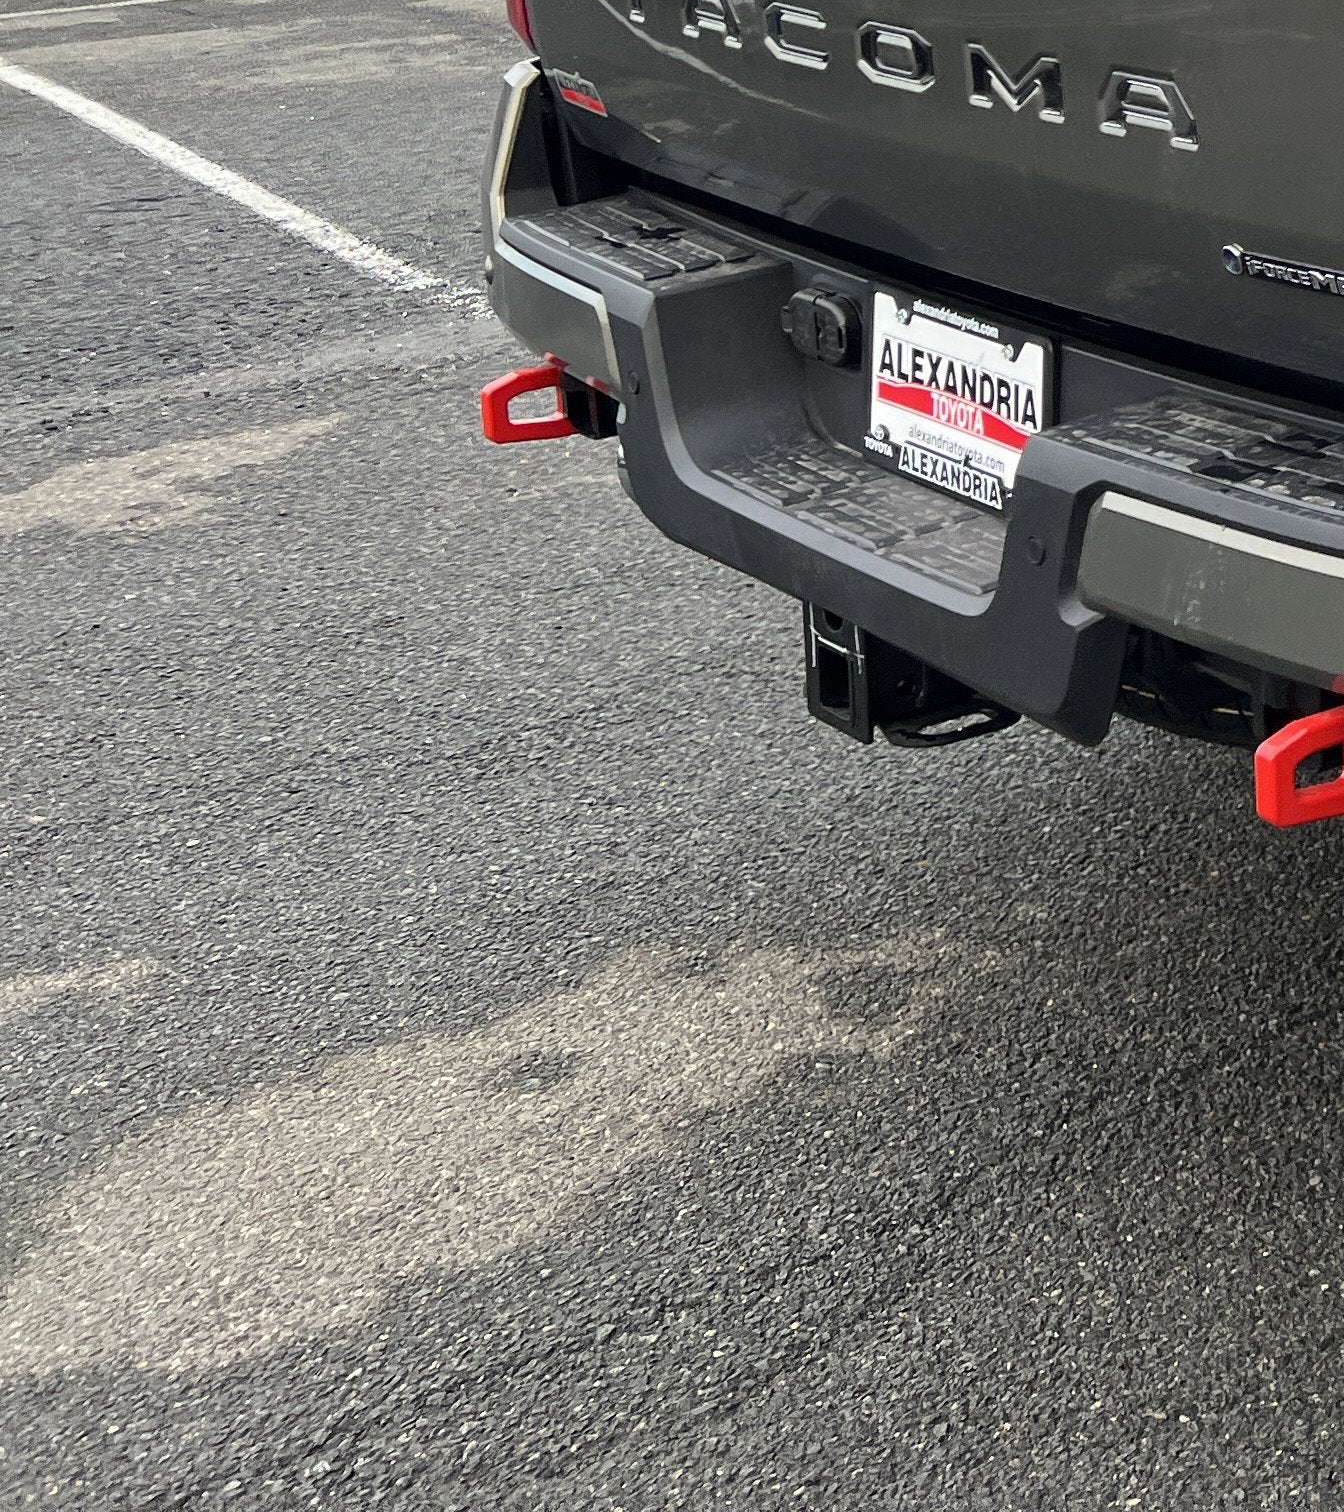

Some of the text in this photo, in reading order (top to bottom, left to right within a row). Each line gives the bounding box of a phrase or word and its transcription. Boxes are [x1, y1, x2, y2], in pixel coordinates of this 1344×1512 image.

[879, 338, 1038, 431] ALEXANDRIA
[930, 392, 985, 437] TOYOTA
[901, 446, 1000, 506] ALEXANDRIA
